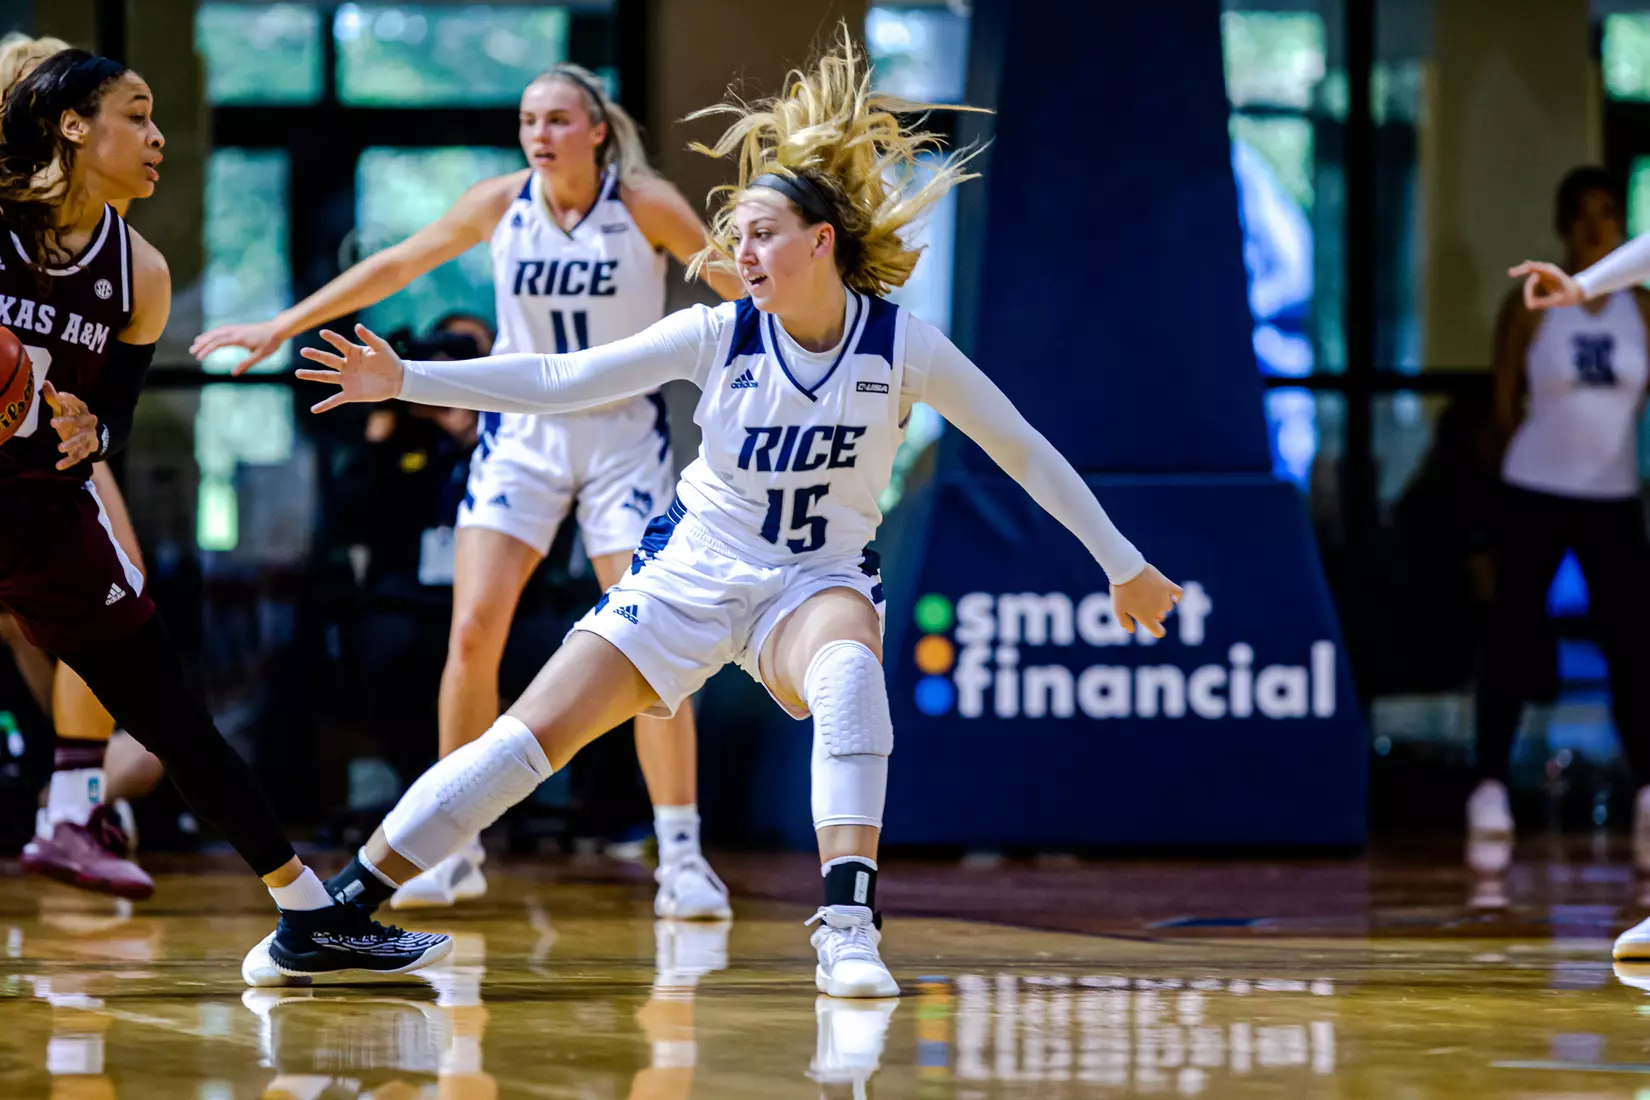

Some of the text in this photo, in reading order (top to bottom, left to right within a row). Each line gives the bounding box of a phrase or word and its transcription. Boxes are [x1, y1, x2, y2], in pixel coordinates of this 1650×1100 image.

[513, 259, 618, 296] RICE
[60, 312, 110, 354] A&M
[550, 310, 588, 355] 11
[737, 424, 868, 472] RICE
[758, 482, 831, 554] 15
[955, 581, 1213, 647] smat
[954, 640, 1336, 719] financial
